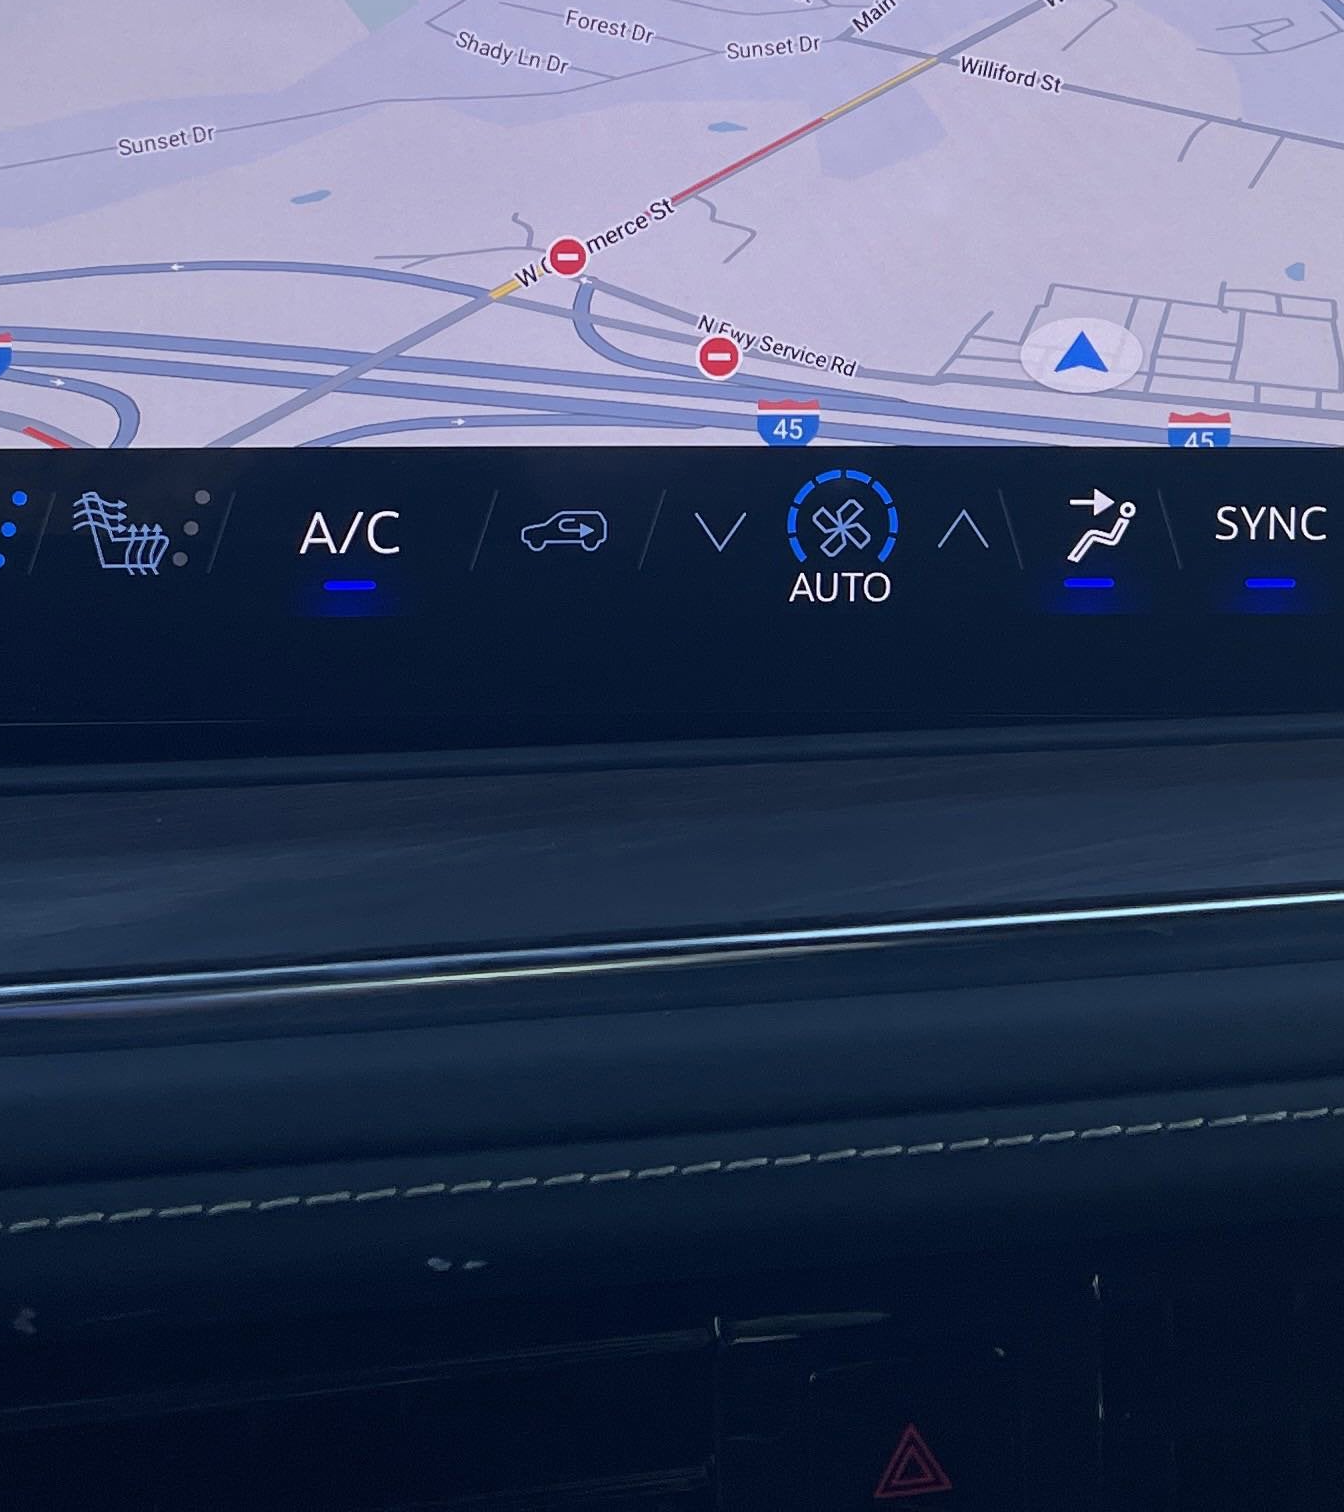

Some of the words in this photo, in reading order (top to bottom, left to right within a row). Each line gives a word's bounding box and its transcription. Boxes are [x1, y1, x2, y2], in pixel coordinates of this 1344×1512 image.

[565, 9, 626, 40] Forest
[630, 24, 655, 44] Dr
[455, 30, 514, 66] Shady
[518, 48, 541, 69] Ln
[545, 55, 569, 75] Dr
[726, 38, 794, 59] Sunset
[798, 34, 821, 53] Dr
[960, 55, 1037, 88] Williford
[1040, 74, 1061, 93] St
[118, 129, 189, 157] Sunset
[193, 125, 216, 144] Dr
[514, 263, 538, 289] W
[649, 198, 675, 222] St
[698, 315, 715, 334] N
[718, 322, 756, 351] Fwy
[759, 336, 827, 370] Service
[830, 356, 857, 378] Rd
[772, 418, 804, 441] 45
[1184, 431, 1216, 448] 45
[299, 510, 400, 555] A/C
[1215, 506, 1328, 542] SYNC
[788, 573, 892, 604] AUTO
